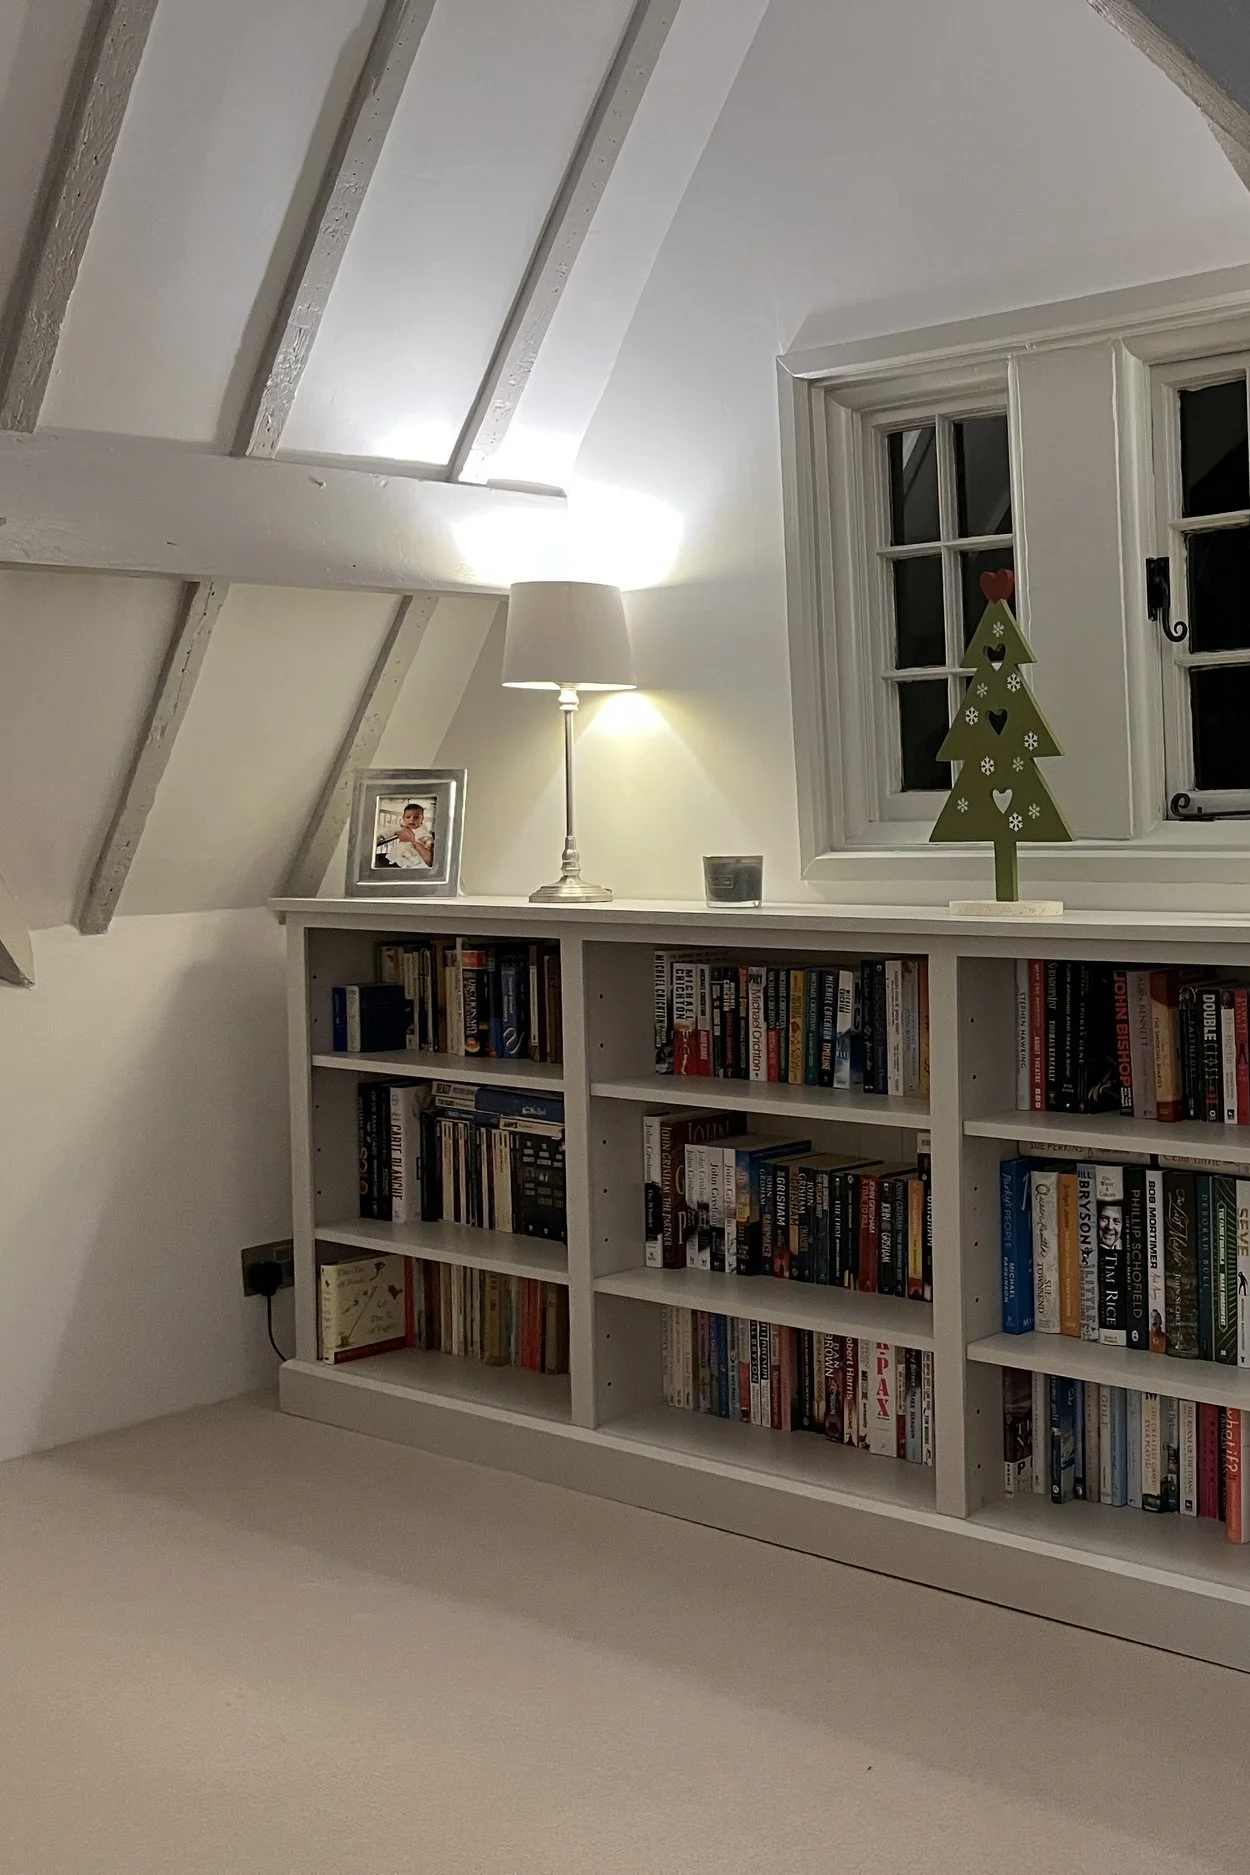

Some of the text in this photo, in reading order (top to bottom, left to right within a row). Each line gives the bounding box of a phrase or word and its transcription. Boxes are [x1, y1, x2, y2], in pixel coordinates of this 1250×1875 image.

[676, 969, 685, 1020] CRICHTON
[685, 969, 693, 1020] MICHAEL
[1203, 994, 1216, 1040] DOUBLE
[751, 989, 762, 1072] Michael Crichton
[1114, 973, 1131, 1087] JOHN BISHOP
[391, 1124, 402, 1200] CARTE BLANCHE
[661, 1126, 674, 1246] JOHN GRISHAM THE PARTNER
[776, 1177, 785, 1225] GRISHAM
[1079, 1180, 1091, 1245] BRYSON
[1238, 1208, 1249, 1256] SEVE
[1105, 1252, 1118, 1325] TIM RICE
[1131, 1190, 1142, 1318] PHILLIP SCHOFIELD
